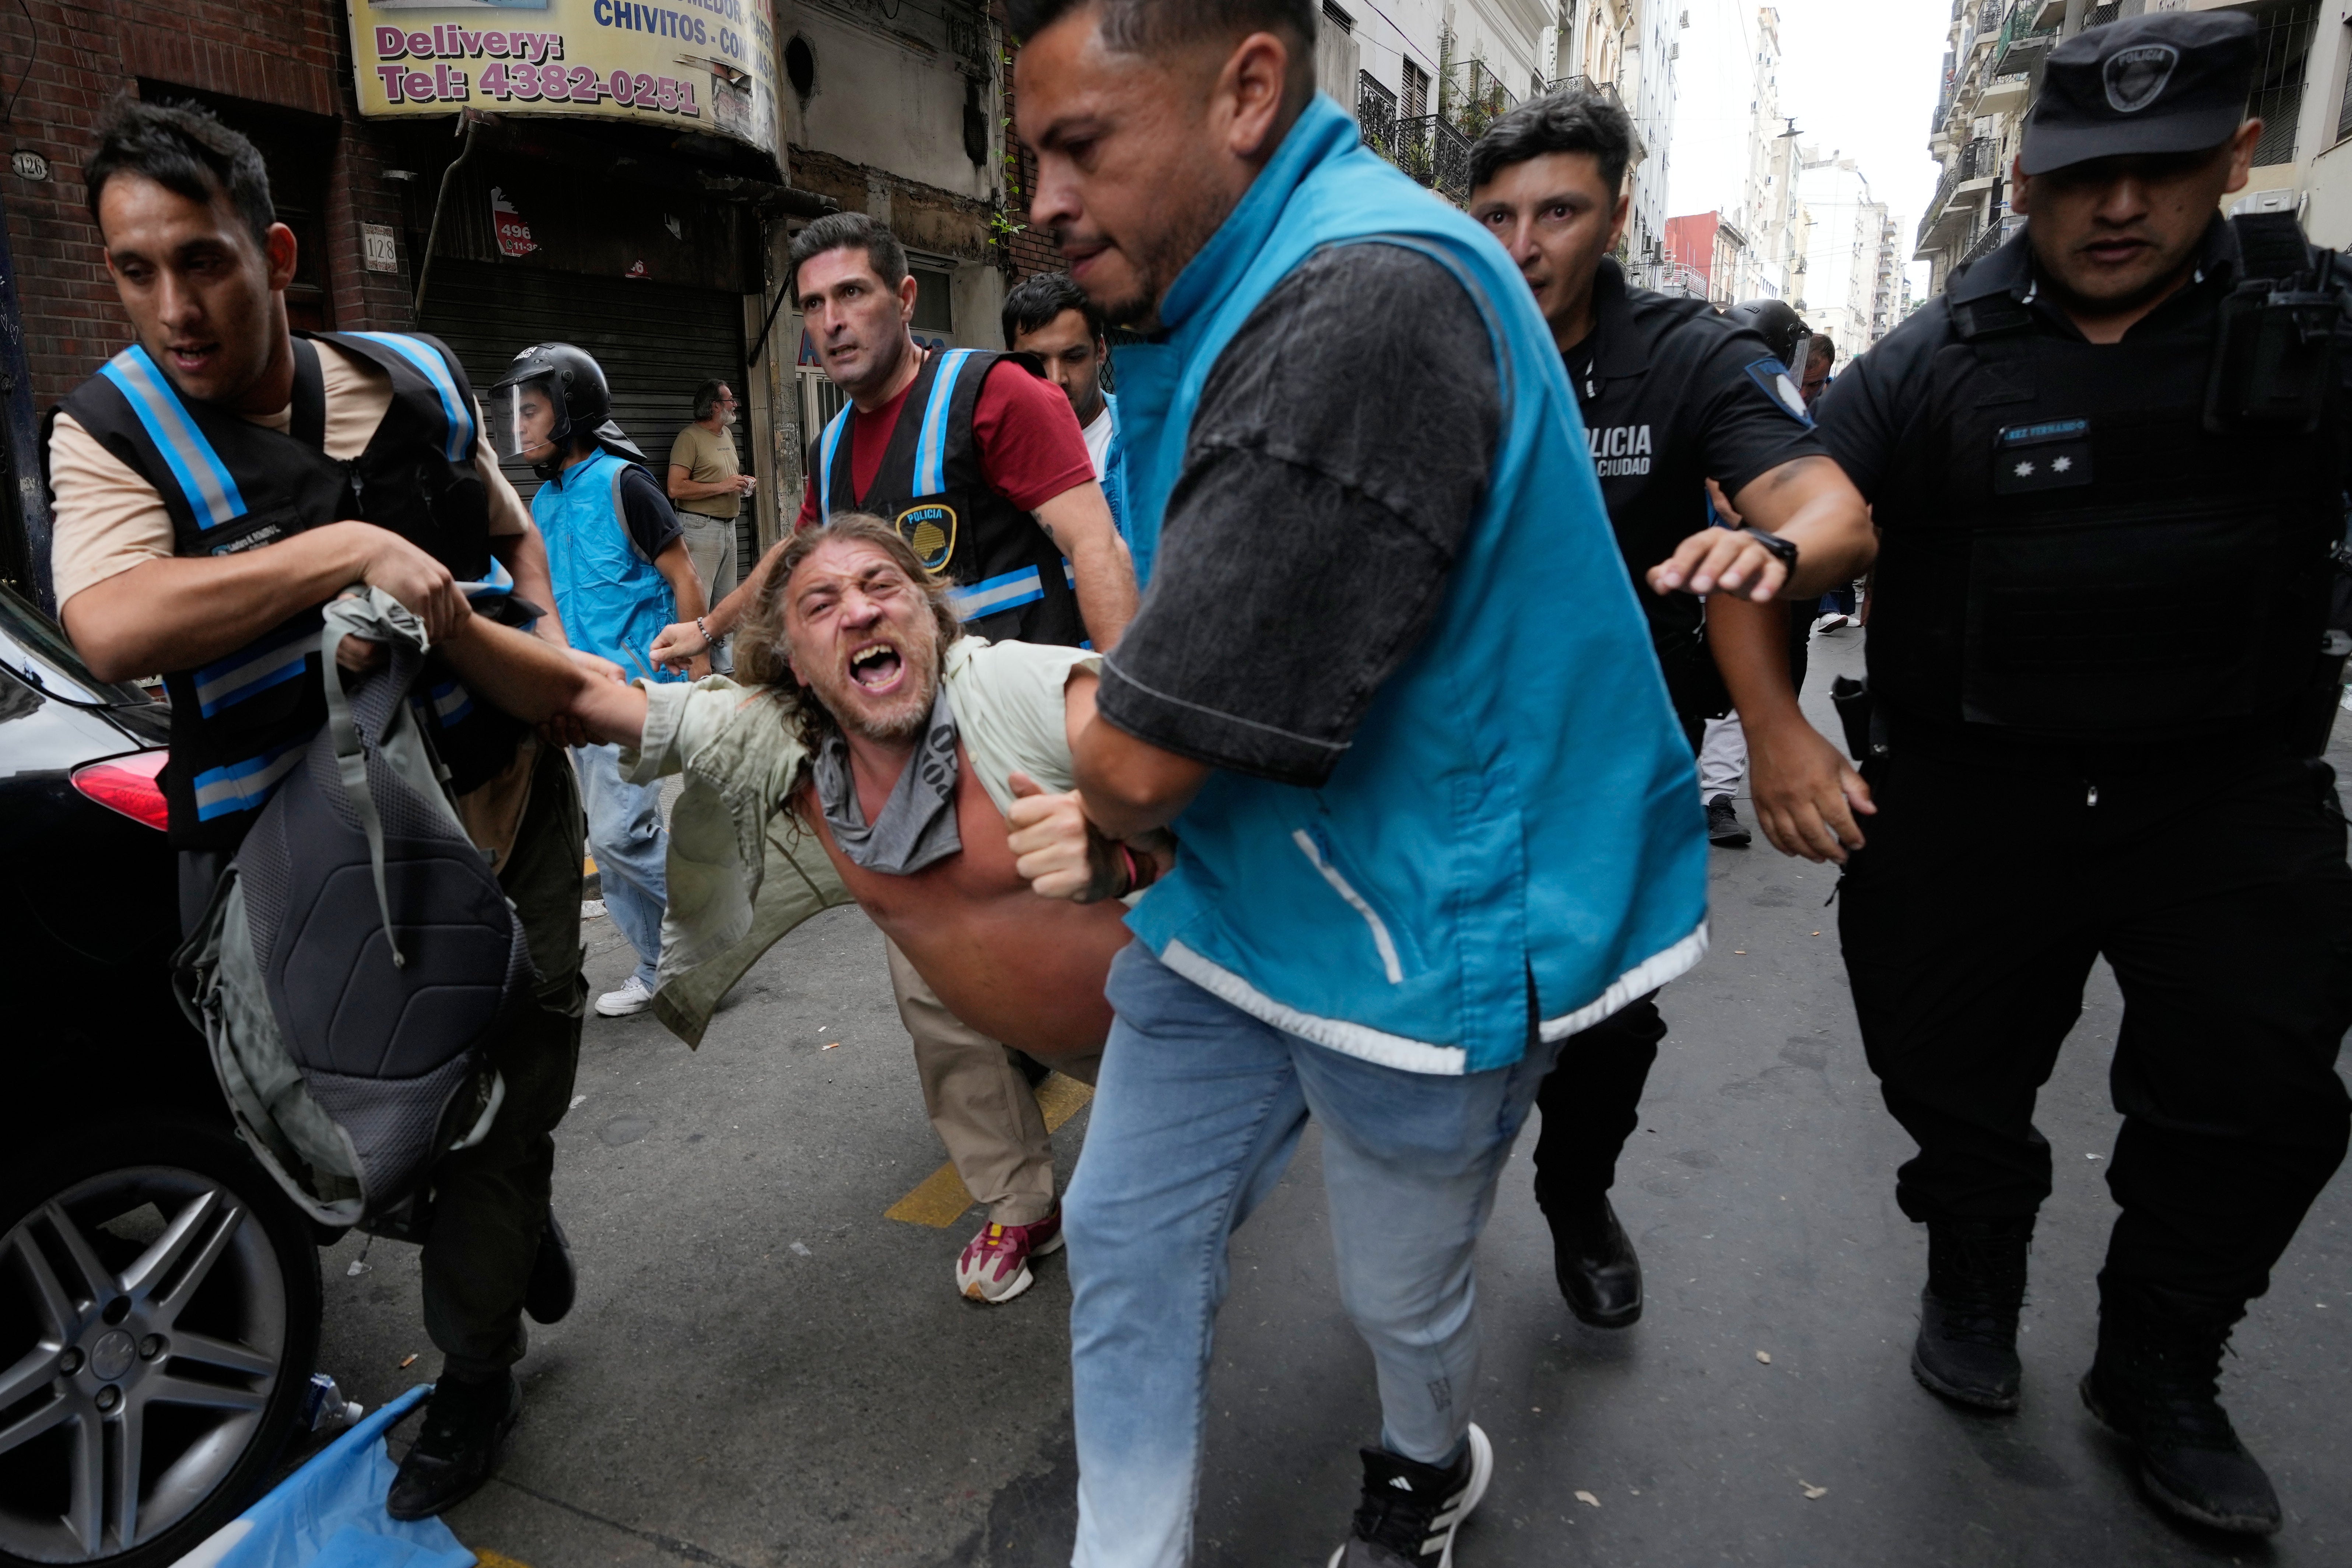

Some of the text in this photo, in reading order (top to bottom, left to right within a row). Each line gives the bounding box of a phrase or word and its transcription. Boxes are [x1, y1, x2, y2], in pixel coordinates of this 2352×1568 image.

[374, 23, 561, 63] Delivery:
[594, 0, 706, 45] CHIVITOS
[720, 28, 768, 79] COMIDAS
[2118, 49, 2166, 67] POLICIA
[375, 62, 699, 115] Tel: 4382-0251
[19, 156, 42, 175] 126
[368, 238, 395, 260] 128
[1582, 424, 1652, 457] LICIA
[1597, 457, 1651, 477] CIUDAD
[907, 508, 943, 525] POLICIA
